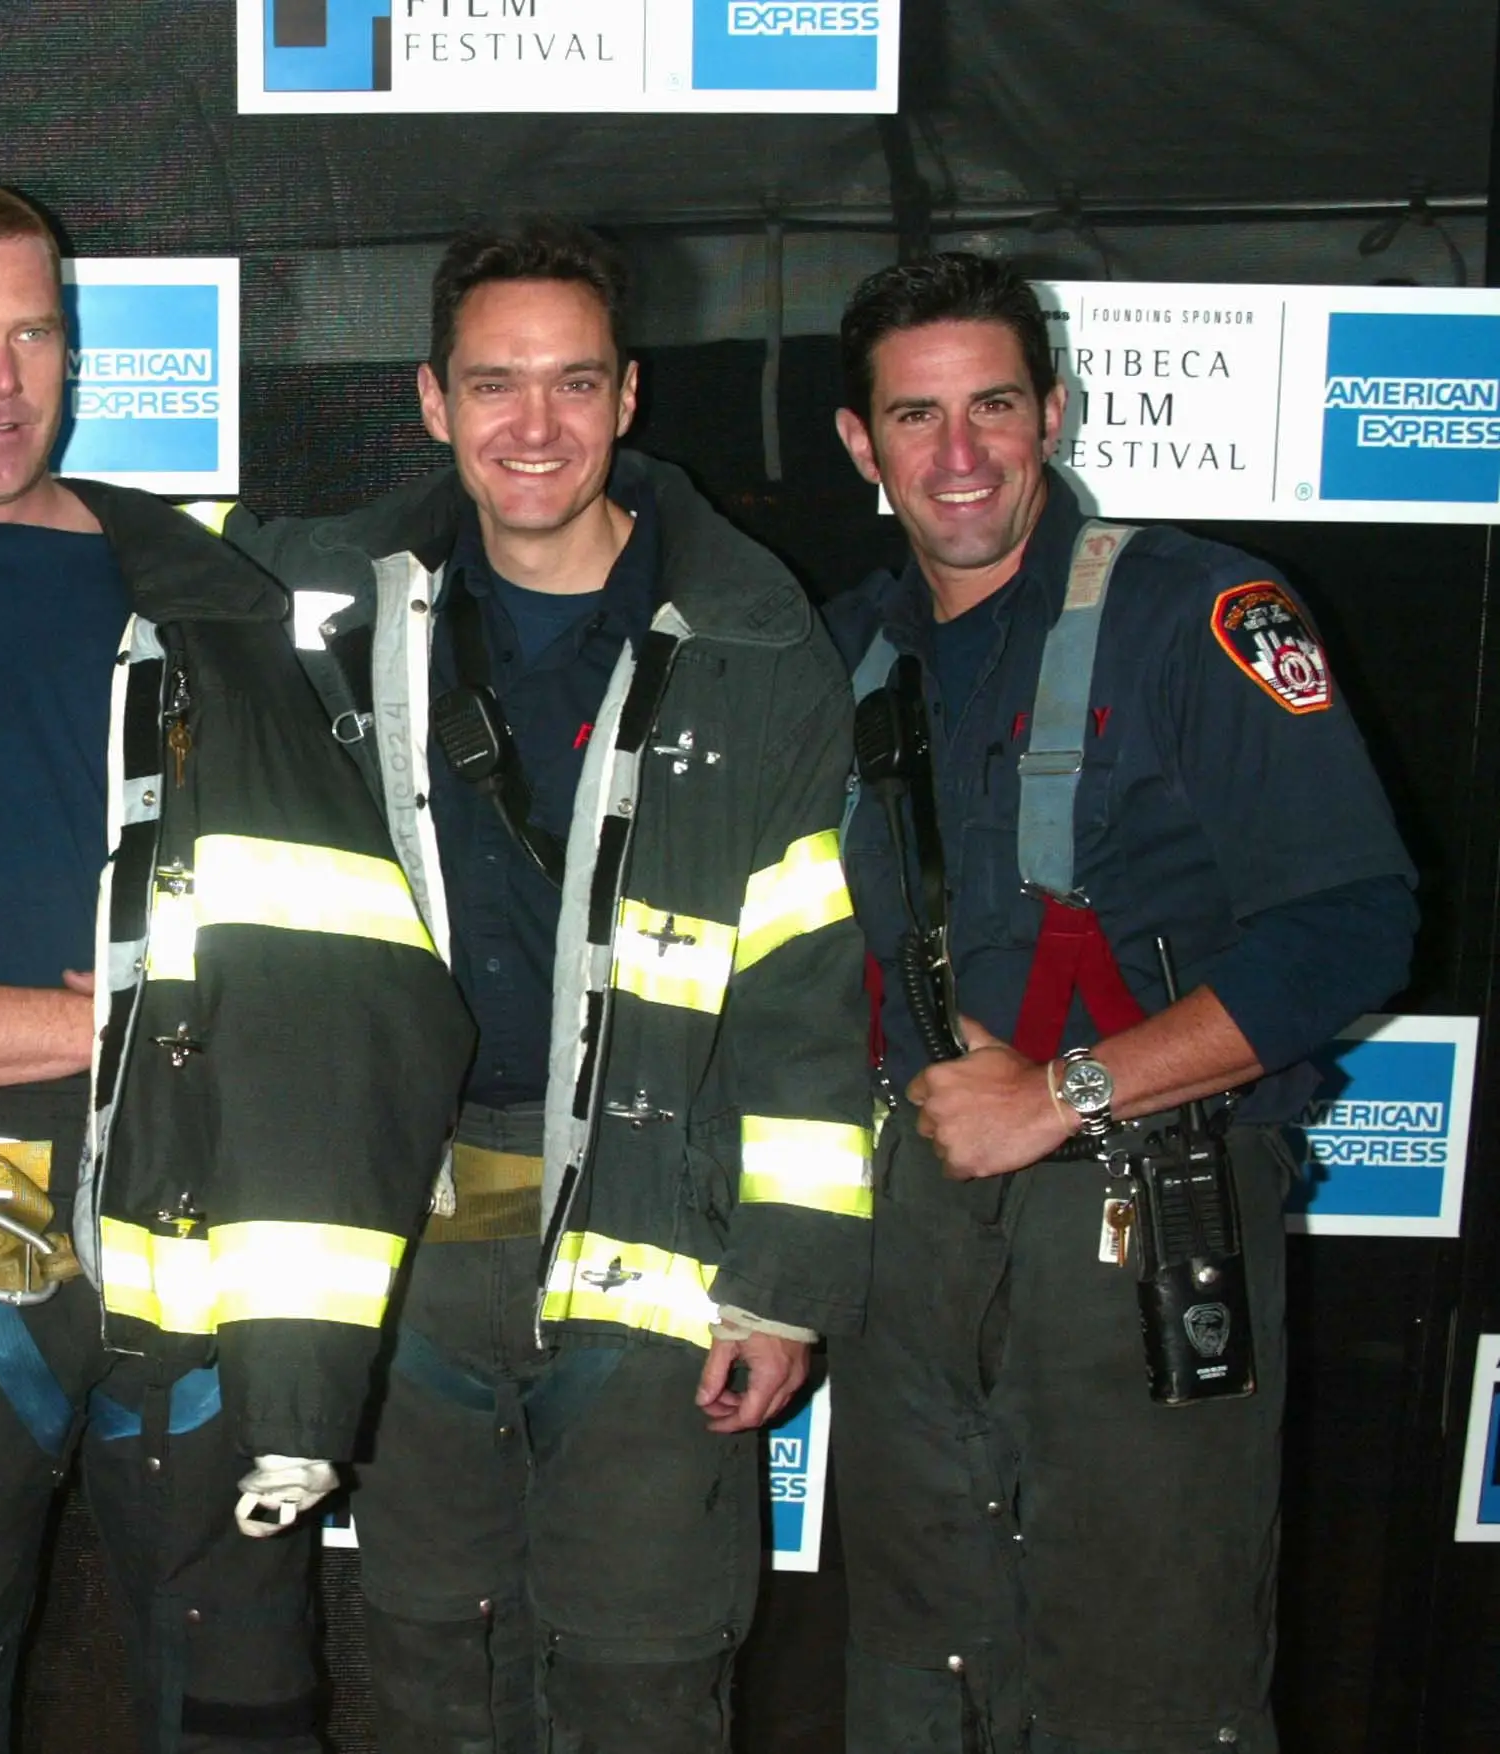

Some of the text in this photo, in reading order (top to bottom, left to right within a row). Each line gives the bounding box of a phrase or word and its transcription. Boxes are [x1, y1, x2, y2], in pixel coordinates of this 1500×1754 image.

[734, 7, 880, 30] EXPRESS
[405, 33, 614, 62] FESTIVAL
[1092, 308, 1254, 325] FOUNDING SPONSOR
[68, 352, 207, 377] MERICAN
[1050, 346, 1231, 379] TRIBECA
[74, 391, 220, 415] EXPRESS
[1326, 381, 1493, 407] AMERICAN
[1080, 390, 1173, 427] ILM
[1363, 419, 1500, 444] EXPRESS
[1058, 439, 1246, 471] ESTIVAL
[1299, 1104, 1438, 1128] MERICAN
[1310, 1139, 1448, 1164] EXPRESS
